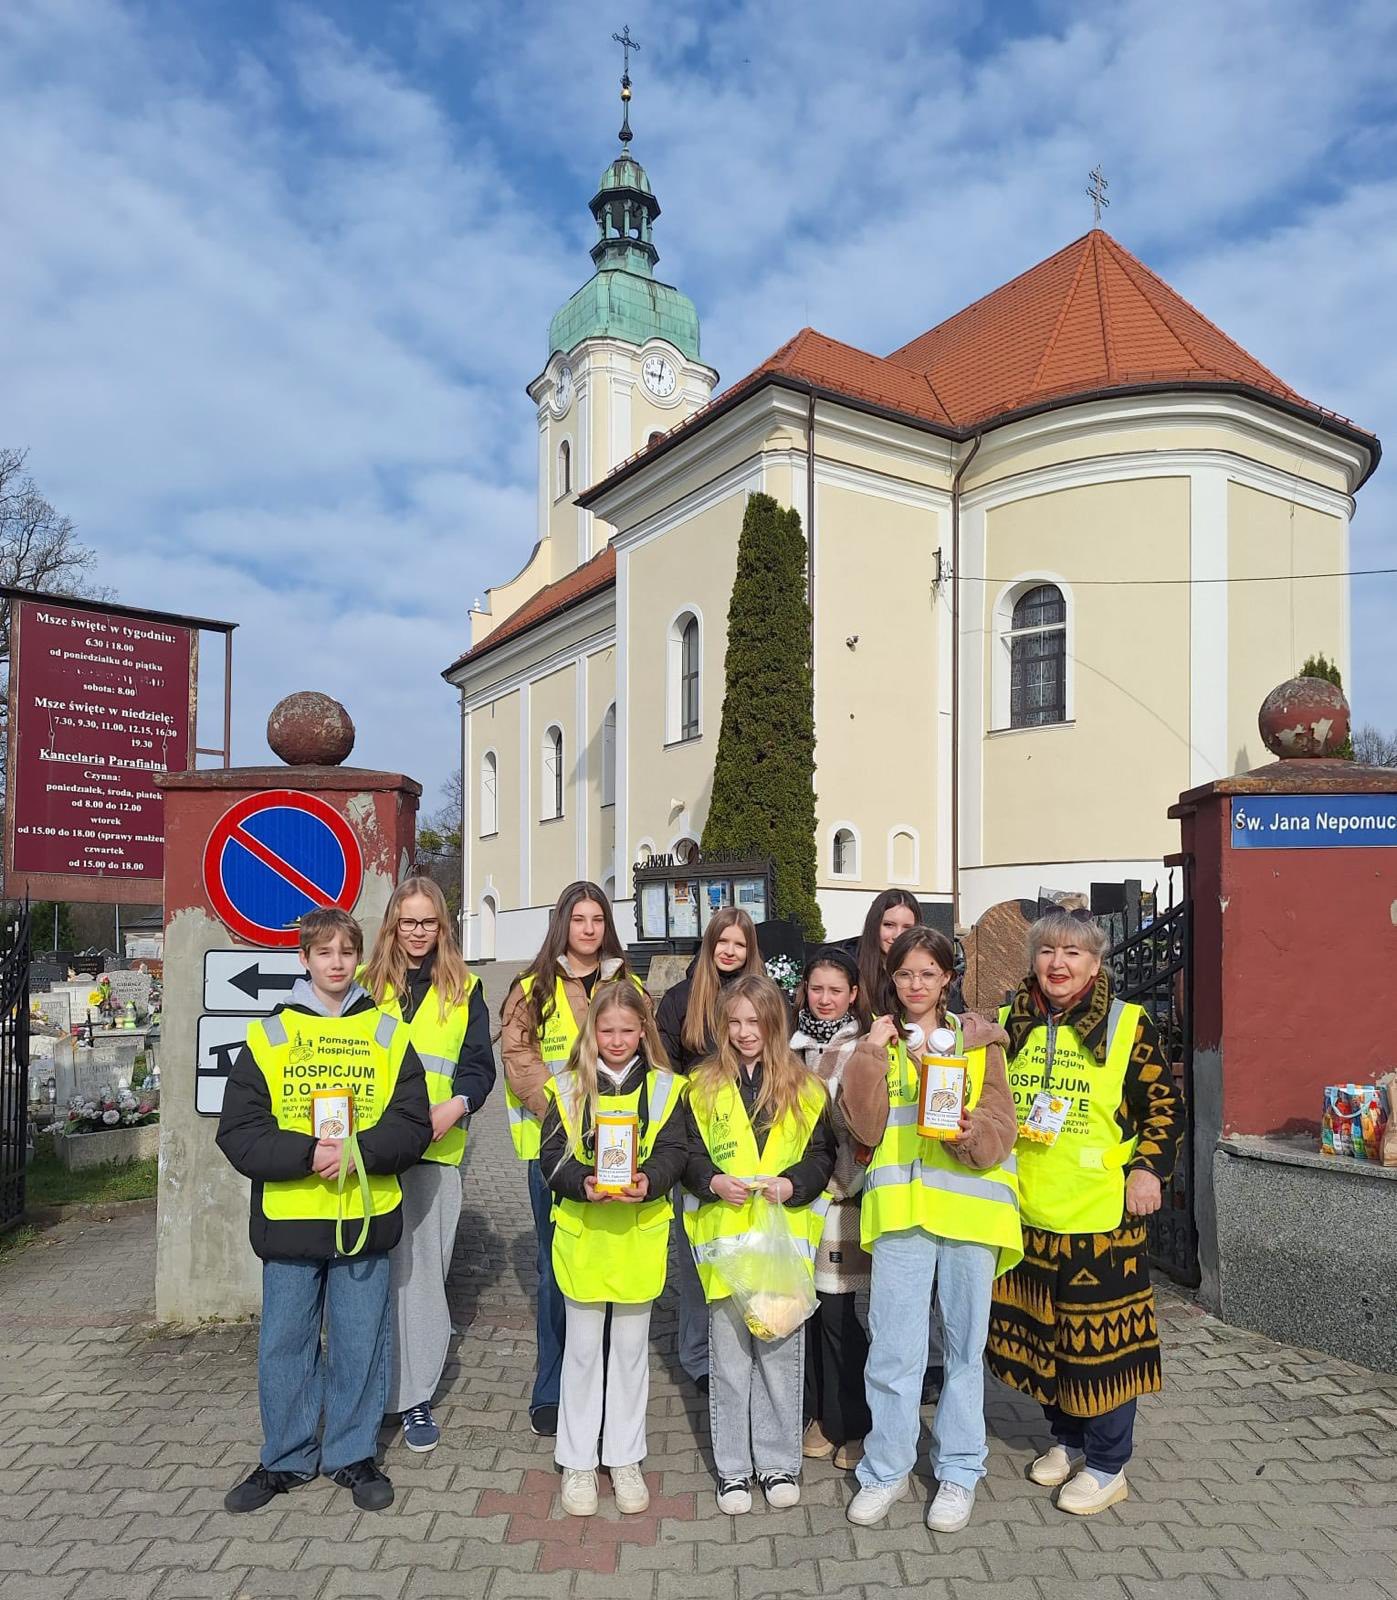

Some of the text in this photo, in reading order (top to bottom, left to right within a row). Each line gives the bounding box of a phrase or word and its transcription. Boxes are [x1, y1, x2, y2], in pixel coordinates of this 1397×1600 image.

[36, 612, 176, 643] Msze święte w tygodniu:
[86, 638, 104, 648] 6.30
[112, 642, 134, 652] 18.00
[50, 648, 61, 656] od
[122, 658, 133, 667] do
[83, 683, 136, 696] sobota: 8.00
[34, 697, 66, 710] Msze
[69, 701, 106, 715] święte
[121, 709, 174, 725] niedzielę:
[54, 716, 75, 726] 7.30,
[78, 719, 99, 729] 9.30,
[101, 722, 126, 733] 11.00,
[129, 725, 153, 736] 12.15,
[131, 739, 153, 748] 19.30
[40, 748, 167, 771] Kancelaria Parafialna
[84, 771, 121, 782] Czynna:
[85, 800, 103, 808] 8.00
[106, 801, 116, 809] do
[120, 803, 142, 812] 12.00
[90, 817, 121, 825] wtorek
[1235, 808, 1264, 830] Św.
[1269, 812, 1310, 830] Jana
[18, 826, 29, 834] od
[32, 827, 56, 835] 15.00
[73, 830, 95, 838] 18.00
[98, 831, 132, 842] (sprawy
[84, 846, 124, 855] czwartek
[83, 860, 106, 868] 15.00
[108, 861, 119, 869] do
[122, 862, 144, 870] 18.00
[319, 1036, 369, 1046] Pomagam
[318, 1047, 370, 1056] Hospicjum
[1031, 1056, 1084, 1070] Hopicjum
[284, 1065, 375, 1078] HOSPICJUM
